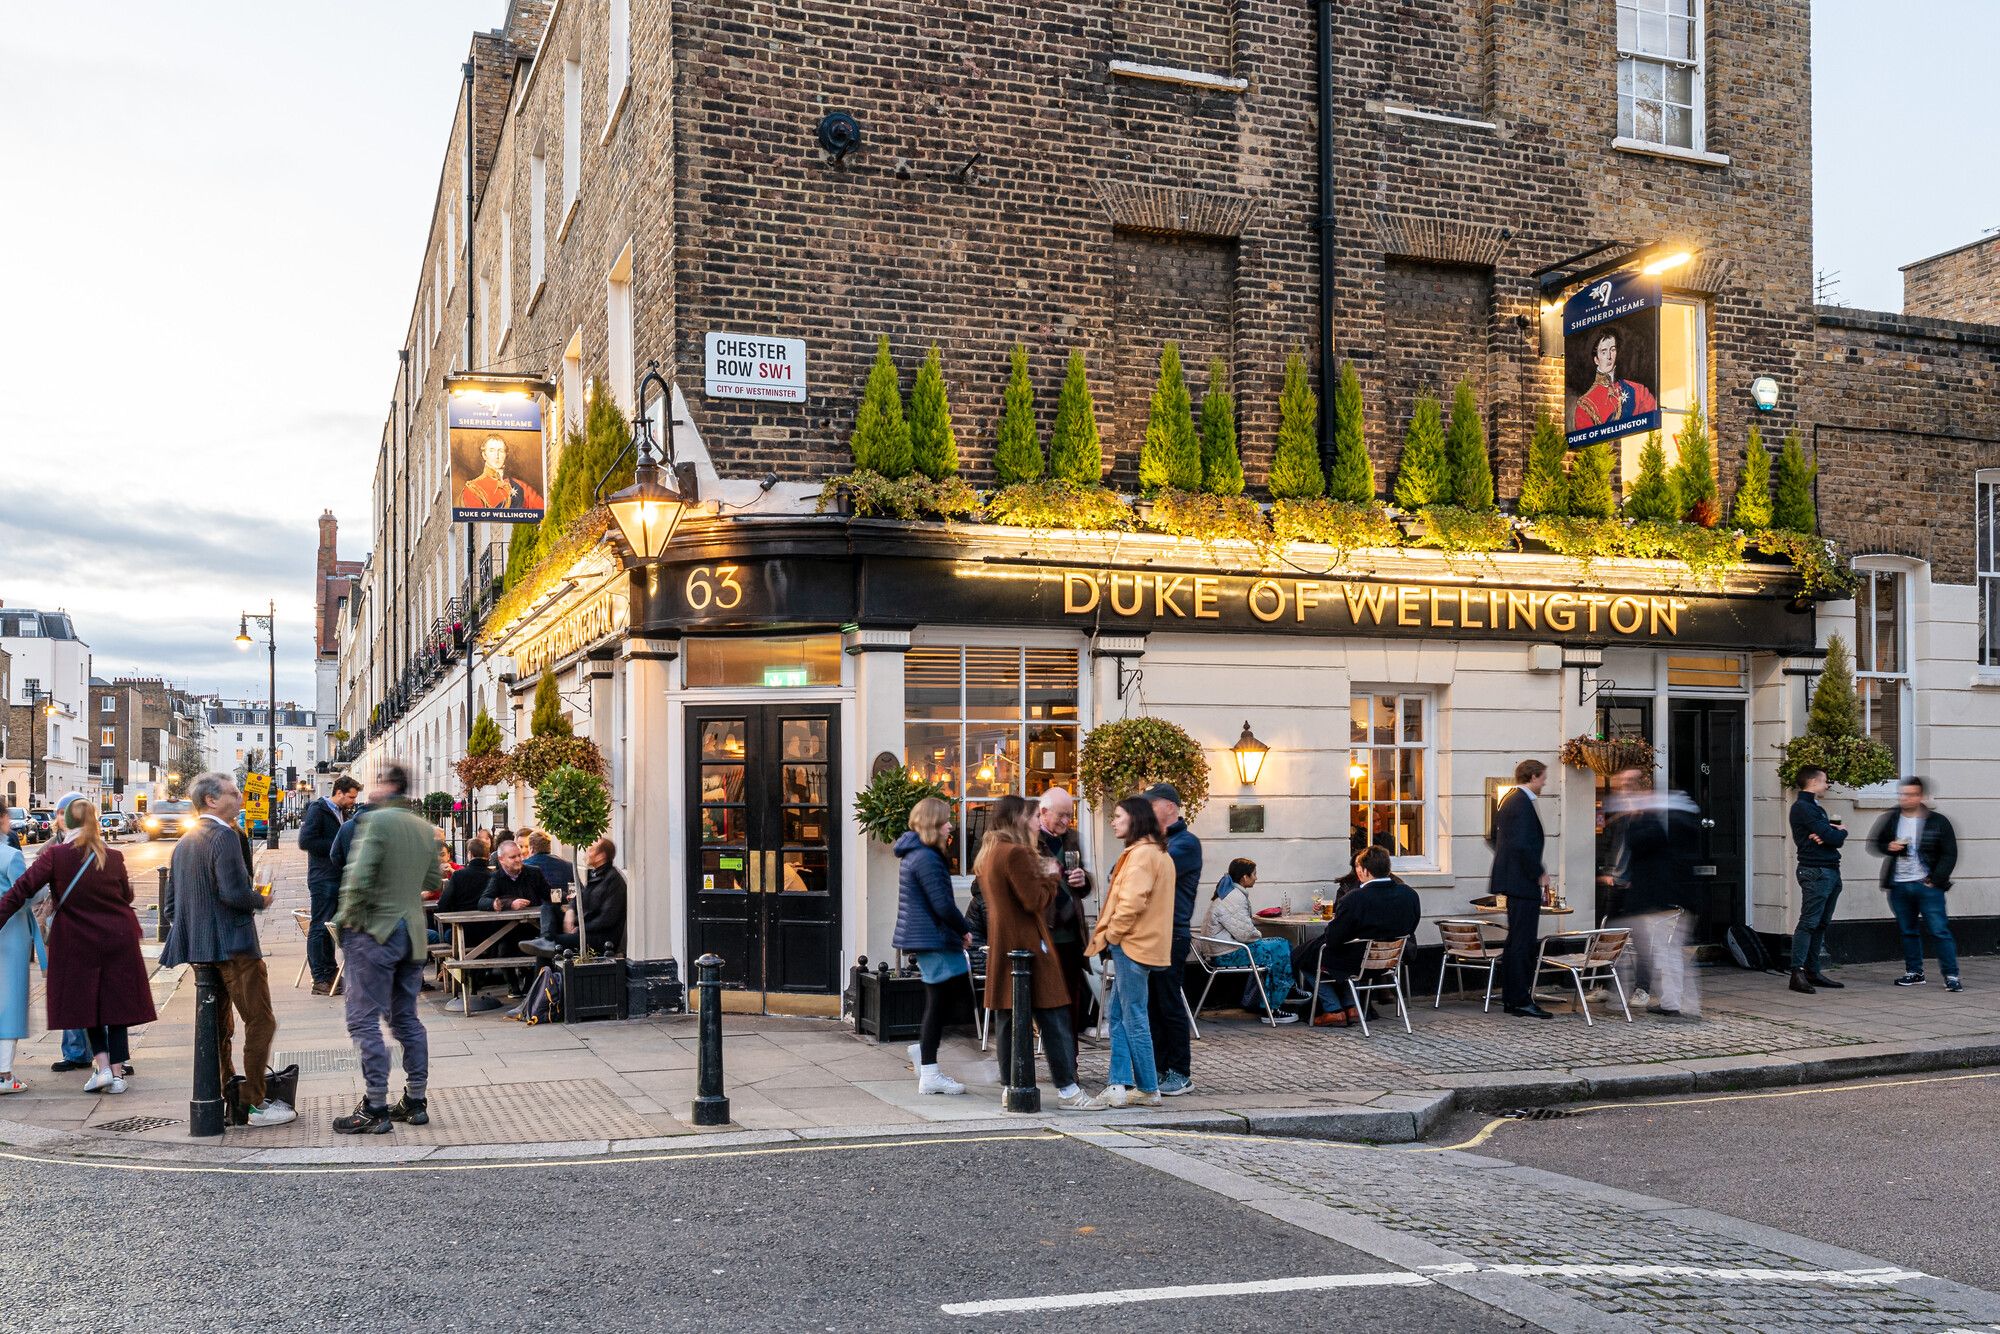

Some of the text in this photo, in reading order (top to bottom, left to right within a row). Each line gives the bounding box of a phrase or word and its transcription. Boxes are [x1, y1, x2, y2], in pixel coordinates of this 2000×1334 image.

[1571, 309, 1614, 329] SHEPHERD
[1615, 298, 1645, 314] NEAME
[716, 339, 786, 360] CHESTER
[716, 360, 792, 380] ROW SW1
[716, 385, 796, 398] CITY OF WESTMINSTER
[458, 418, 533, 428] SHEPHERD NEAME
[1568, 418, 1648, 444] DUKE OF WELLINGTON
[685, 566, 743, 610] 63
[1063, 571, 1678, 637] DUKE OF WELLINGTON
[1700, 763, 1710, 775] 63
